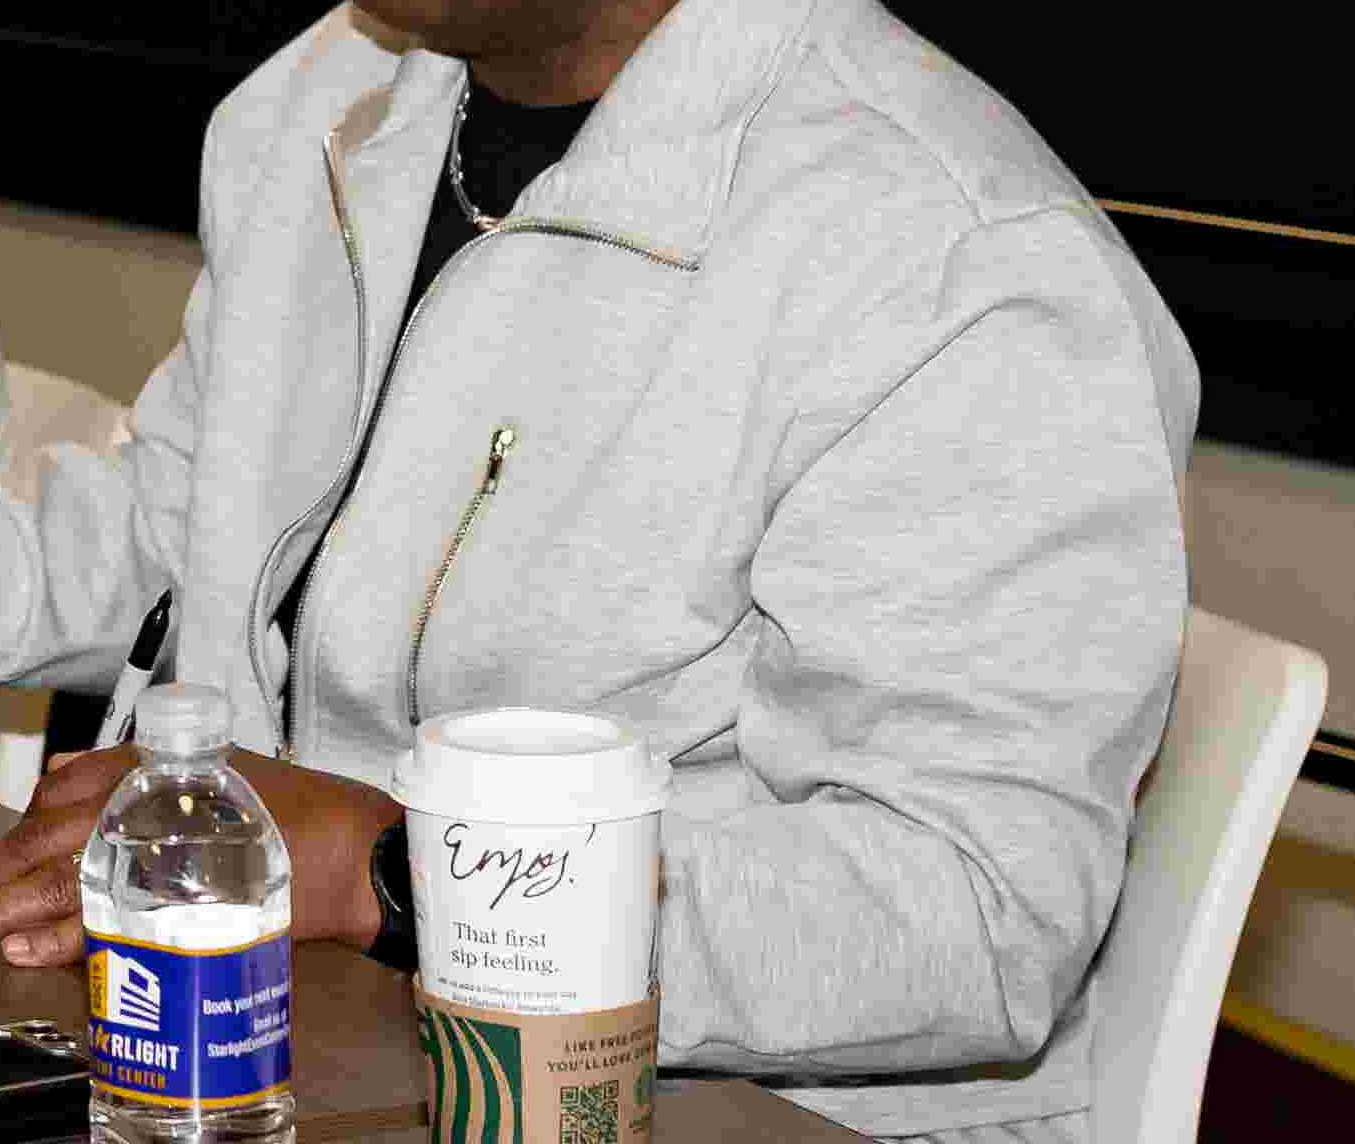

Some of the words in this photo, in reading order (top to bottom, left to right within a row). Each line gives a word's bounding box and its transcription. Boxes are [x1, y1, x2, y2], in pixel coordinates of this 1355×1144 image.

[452, 920, 497, 945] That
[505, 928, 546, 948] first
[450, 944, 477, 969] sip
[483, 951, 560, 976] feeling.
[202, 998, 233, 1016] Book
[545, 1055, 601, 1072] YOU'LL
